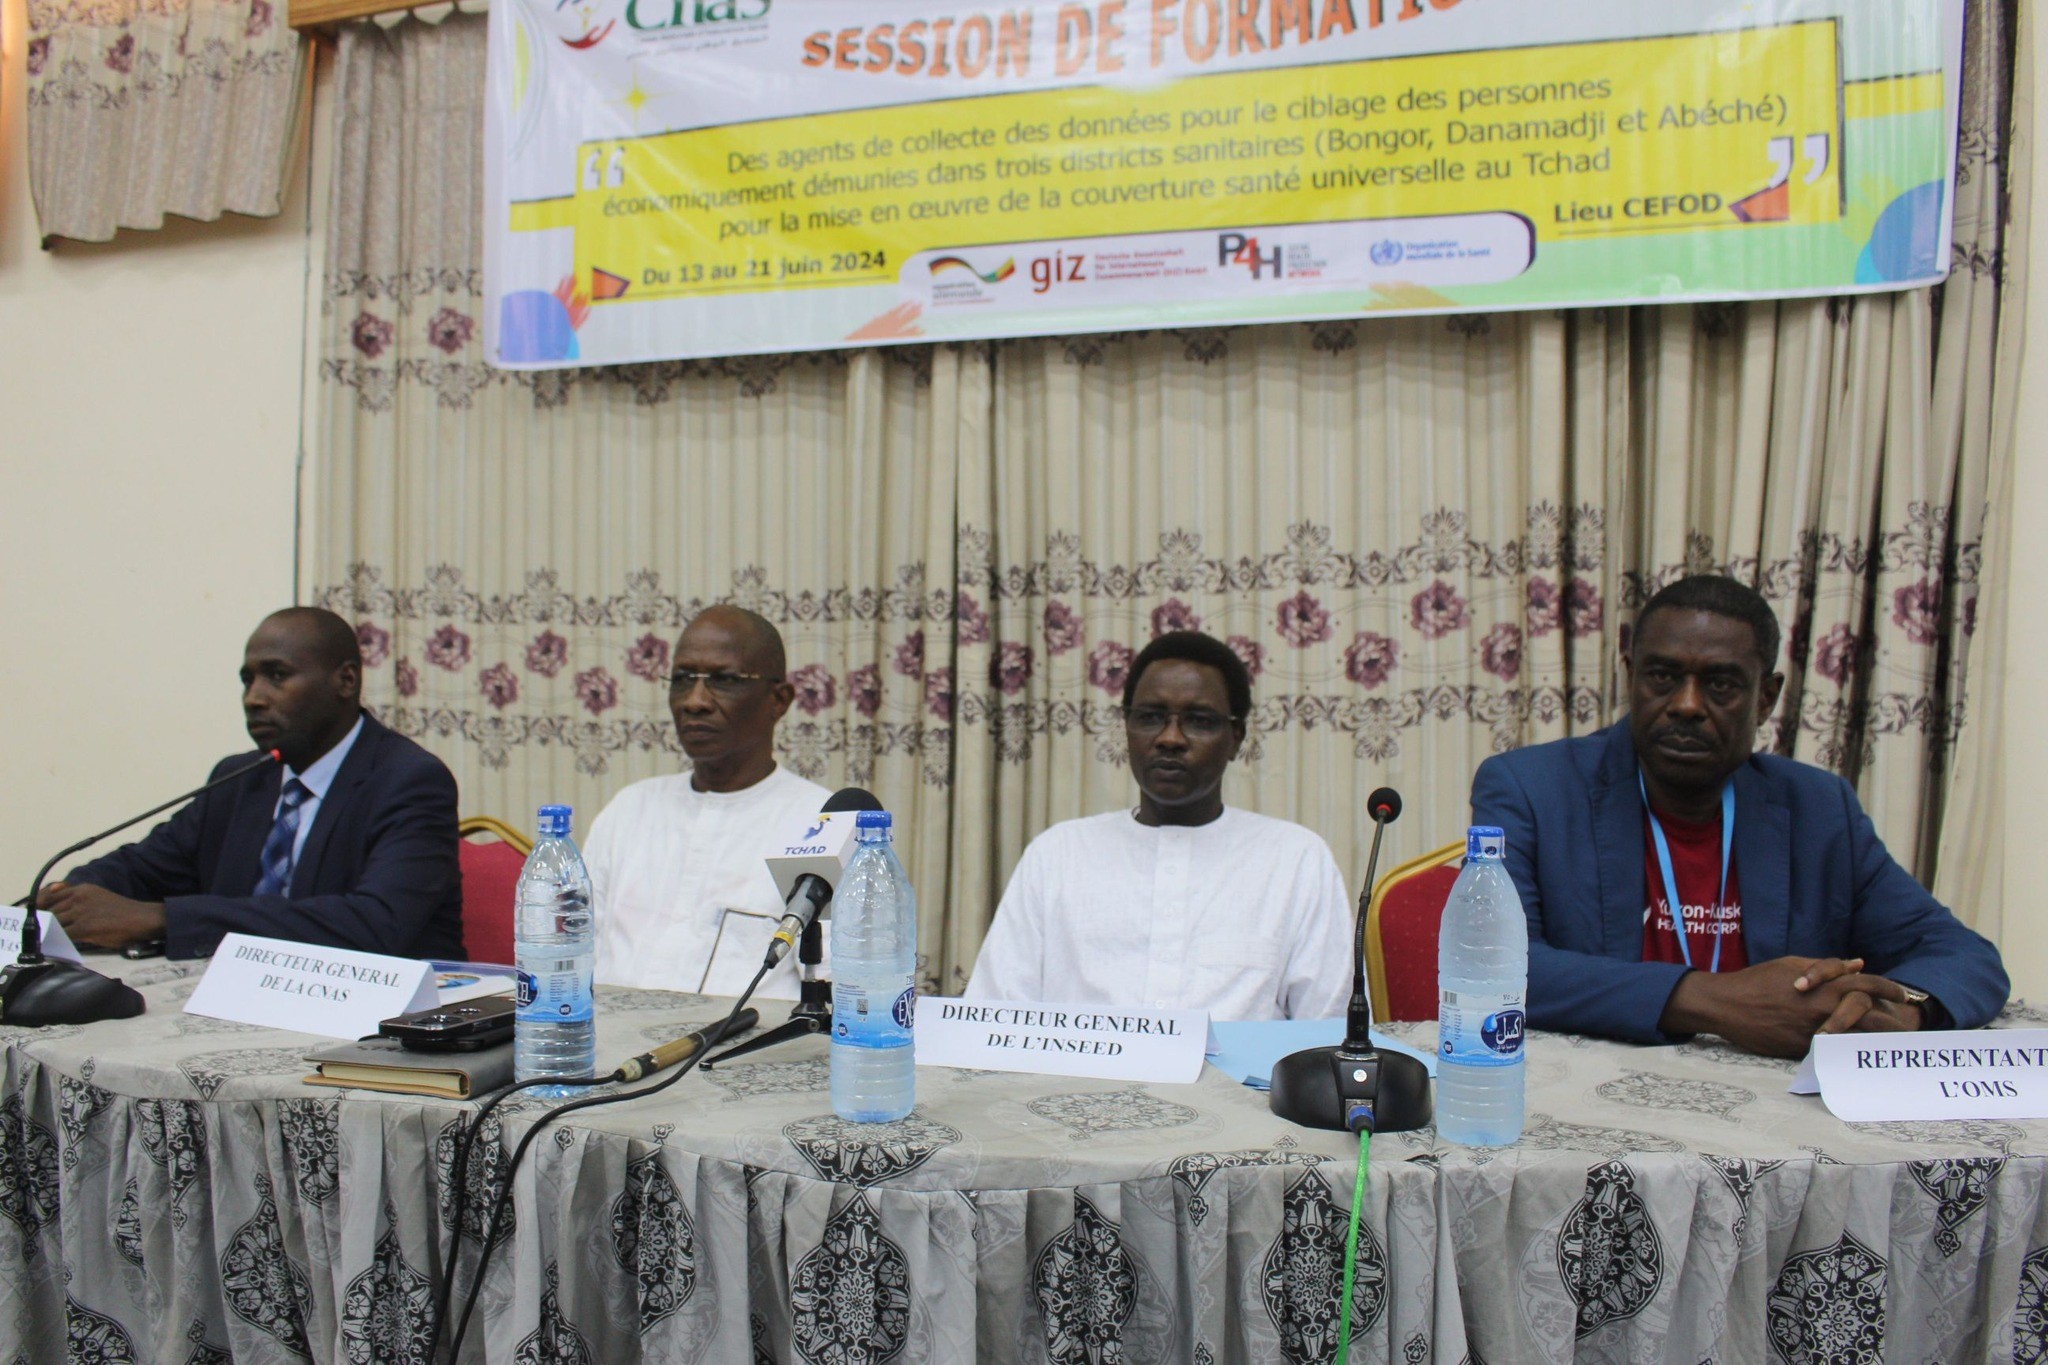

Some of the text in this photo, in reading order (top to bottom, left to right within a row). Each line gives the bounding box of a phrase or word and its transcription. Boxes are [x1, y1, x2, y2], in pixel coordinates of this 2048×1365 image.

[801, 8, 1032, 79] SESSION
[1054, 0, 1125, 77] DE
[727, 77, 1612, 173] Des agents de collecte des données pour le ciblage des personnes
[603, 94, 1788, 217] économiquement démunies dans trois districts sanitaires (Bongor, Danamadji et Abéché)
[719, 147, 1611, 240] pour la mise en œuvre de la couverture santé universelle au Tchad
[1554, 193, 1722, 223] Lieu CEFOD
[642, 250, 887, 285] Du 13 au 21 juin 2024
[1031, 249, 1086, 294] giz
[1218, 233, 1281, 279] P4H
[784, 845, 827, 856] TCHAD
[1657, 918, 1704, 935] HEATH
[234, 944, 402, 989] DIRECTEUR GENERAL
[260, 973, 352, 1003] DE LA CNAS
[941, 1004, 1182, 1036] DIRECTEUR GENERAL
[987, 1032, 1123, 1056] DE L’INSEED
[1856, 1048, 2048, 1069] REPRESENTANT
[1939, 1079, 2018, 1099] L’OMS
